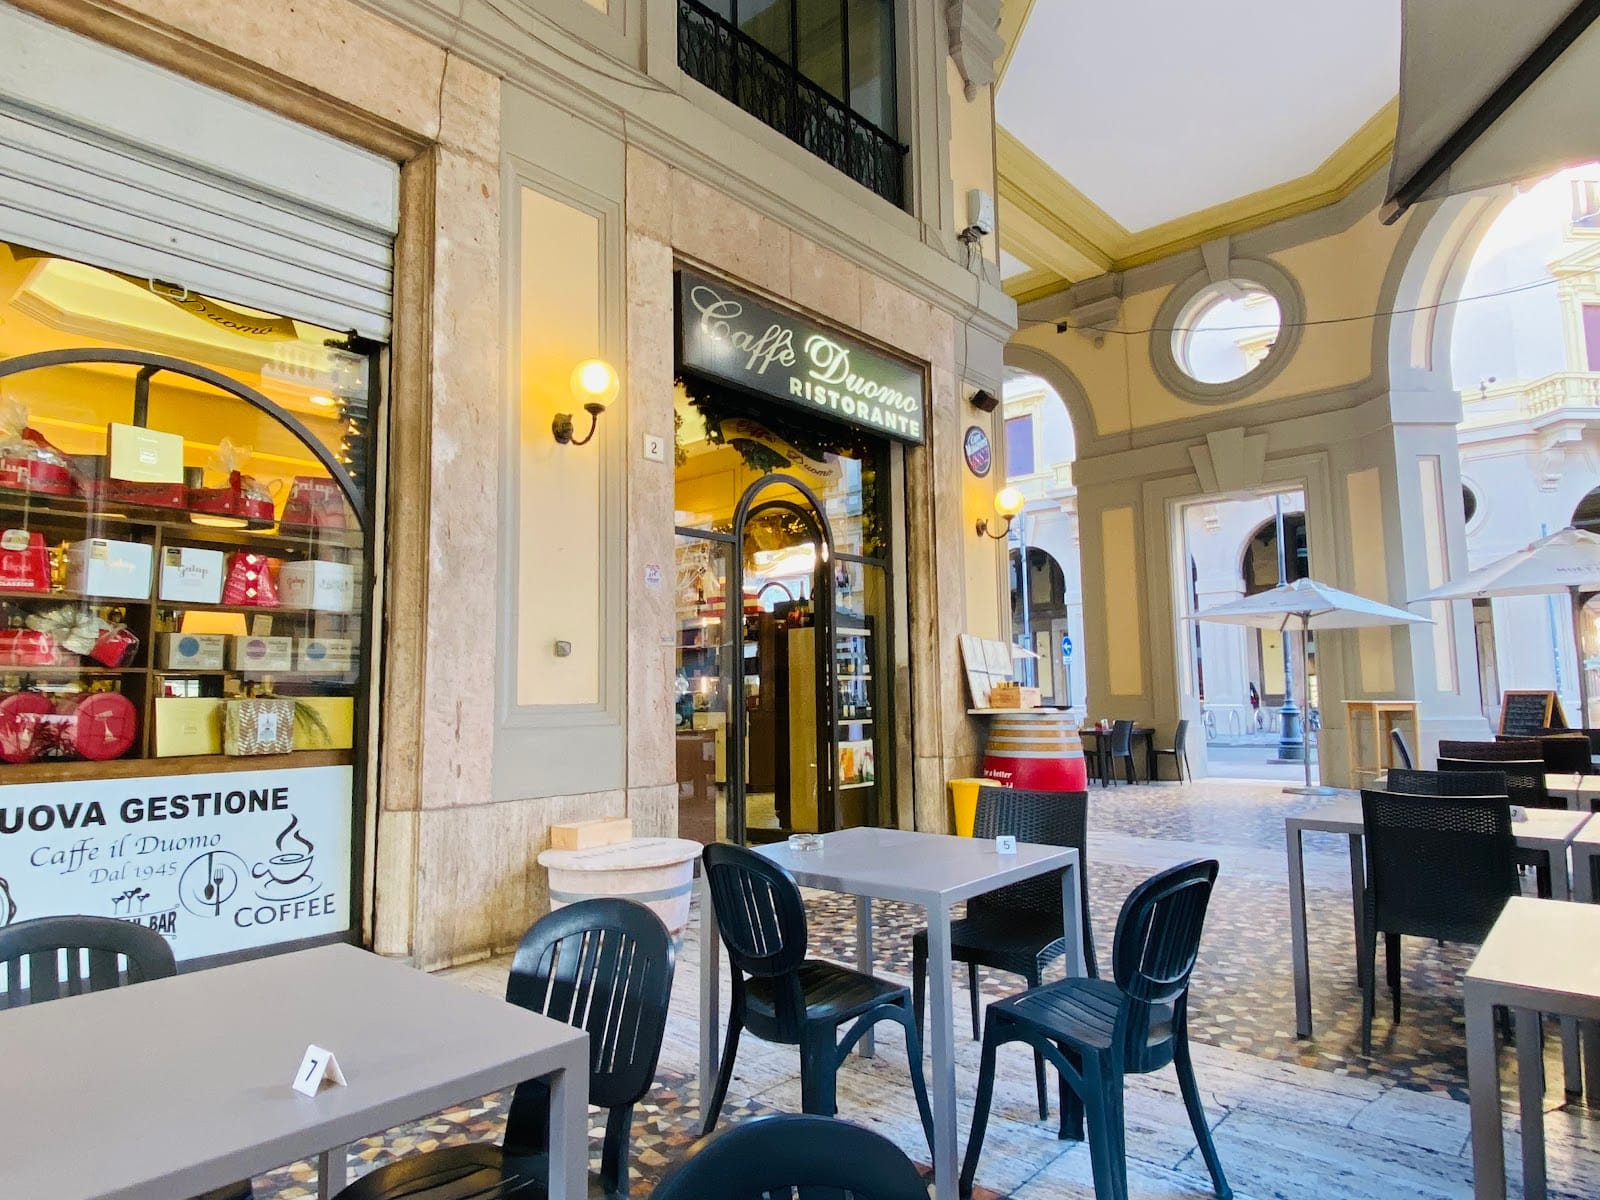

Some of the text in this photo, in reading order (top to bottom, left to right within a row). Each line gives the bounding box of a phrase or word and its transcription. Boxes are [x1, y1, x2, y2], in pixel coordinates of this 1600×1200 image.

[690, 285, 919, 413] Caffè Duomo
[789, 376, 920, 438] RISTORANTE
[651, 441, 658, 454] 2
[120, 787, 289, 823] GESTIONE
[30, 833, 221, 874] Caffe il Duomo
[1003, 840, 1010, 850] 5
[89, 861, 177, 884] Dal 1945
[149, 911, 177, 934] BAR
[234, 893, 336, 928] COFFEE
[305, 1059, 318, 1082] 7
